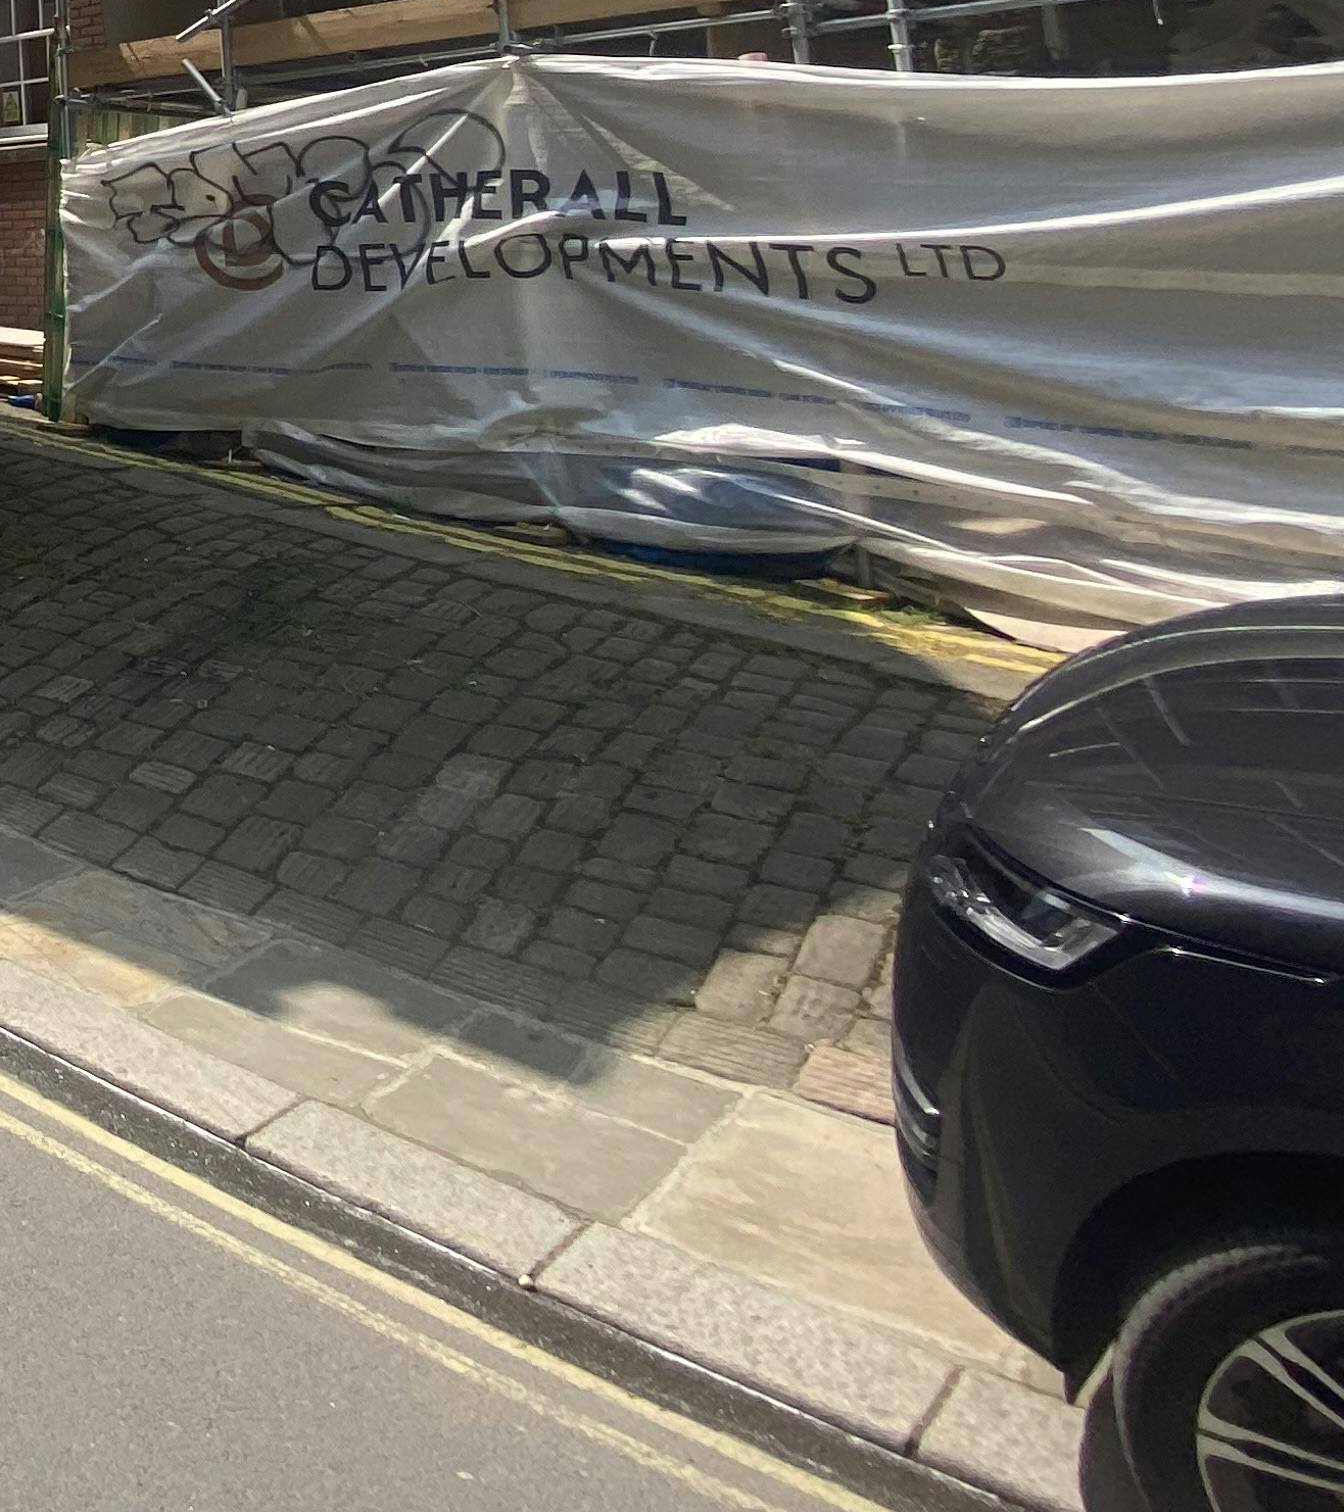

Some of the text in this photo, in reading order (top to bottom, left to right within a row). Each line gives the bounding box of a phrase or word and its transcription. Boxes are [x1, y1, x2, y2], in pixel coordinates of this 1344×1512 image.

[308, 168, 687, 227] CATHERALL
[312, 232, 1007, 304] DEVELOPMENTS LTD
